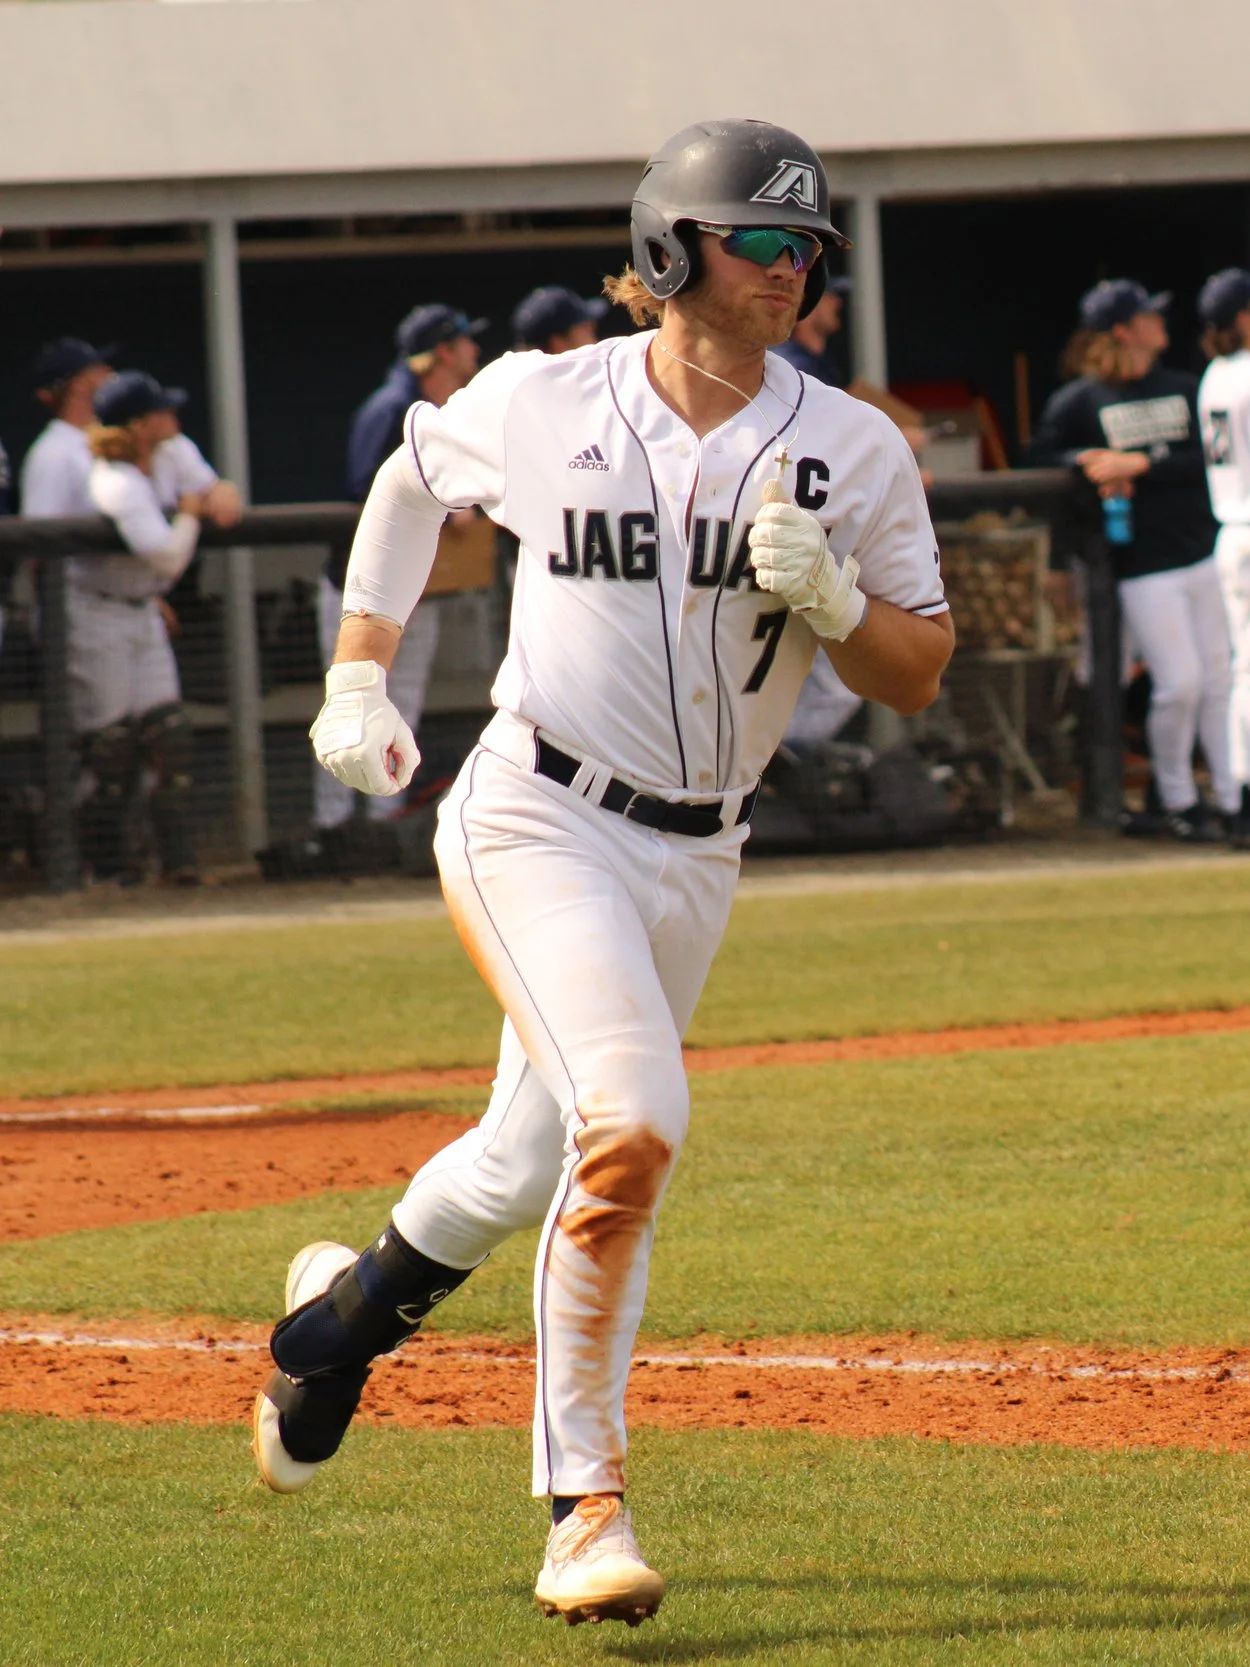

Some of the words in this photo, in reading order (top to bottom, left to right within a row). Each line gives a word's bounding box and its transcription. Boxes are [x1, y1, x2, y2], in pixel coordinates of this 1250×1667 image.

[749, 159, 818, 212] A
[568, 458, 610, 472] adidas
[795, 457, 830, 511] C
[548, 507, 832, 593] JAGUA
[741, 608, 788, 694] 7
